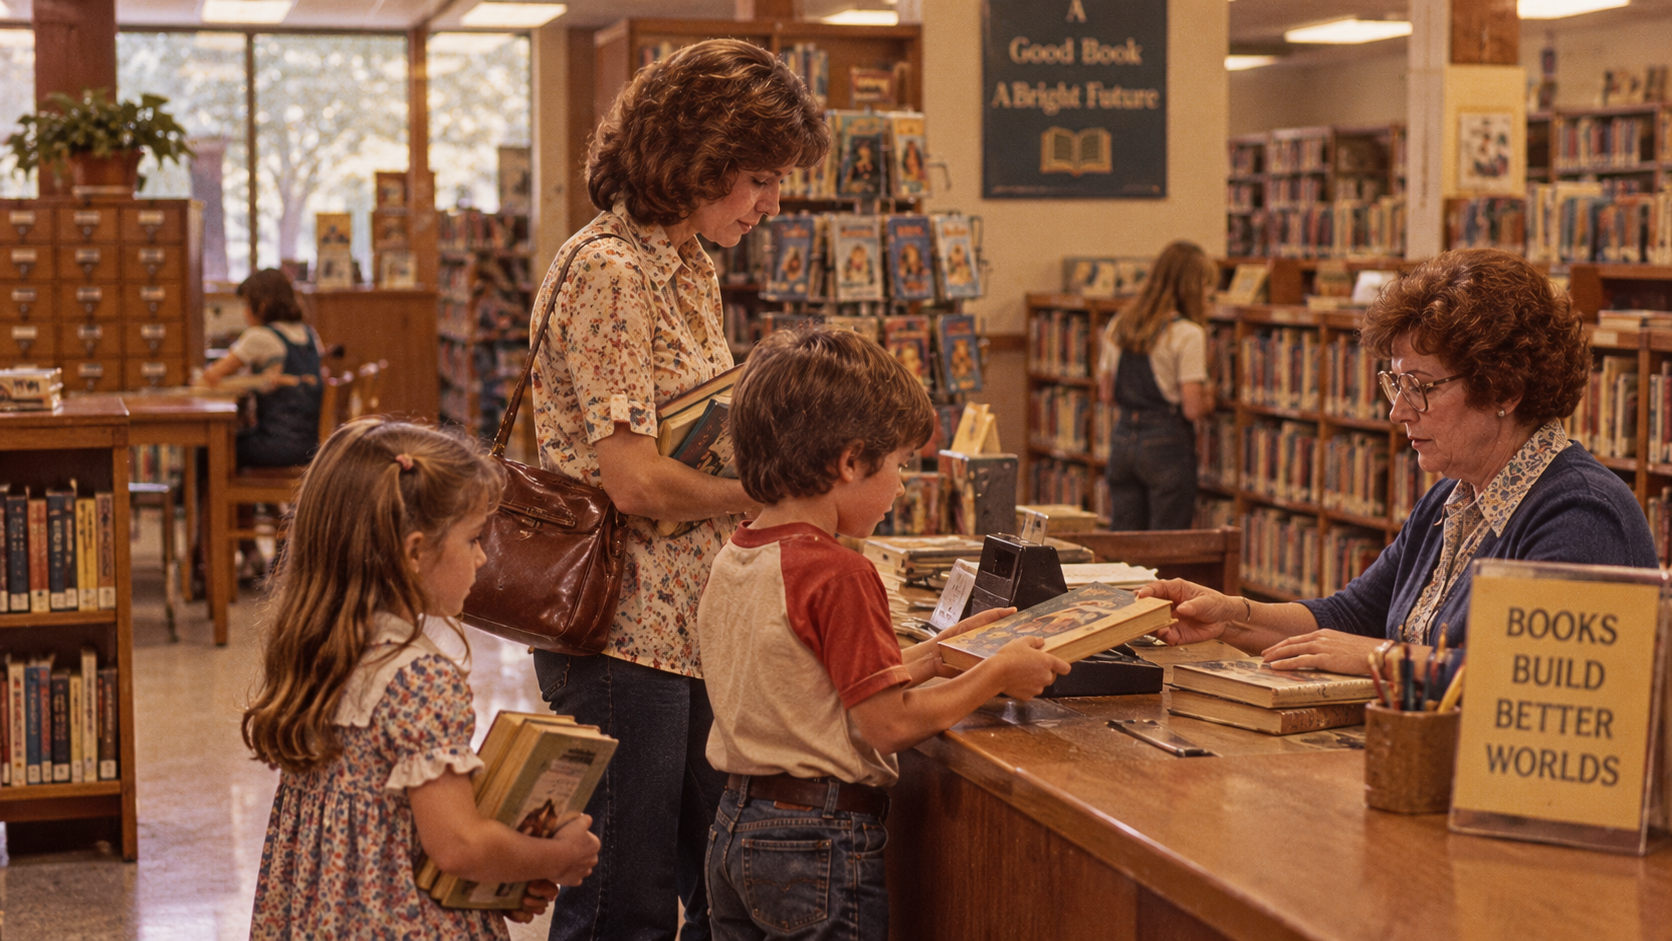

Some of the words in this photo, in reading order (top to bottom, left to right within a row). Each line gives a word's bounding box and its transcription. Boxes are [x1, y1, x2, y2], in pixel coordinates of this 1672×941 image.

[1066, 0, 1087, 23] A
[1009, 36, 1074, 65] Good
[1081, 37, 1143, 65] Book
[1086, 81, 1160, 109] Future
[1506, 607, 1619, 646] BOOKS
[1512, 654, 1606, 690] BUILD
[1494, 698, 1615, 739] BETTER
[1485, 743, 1621, 787] WORLDS
